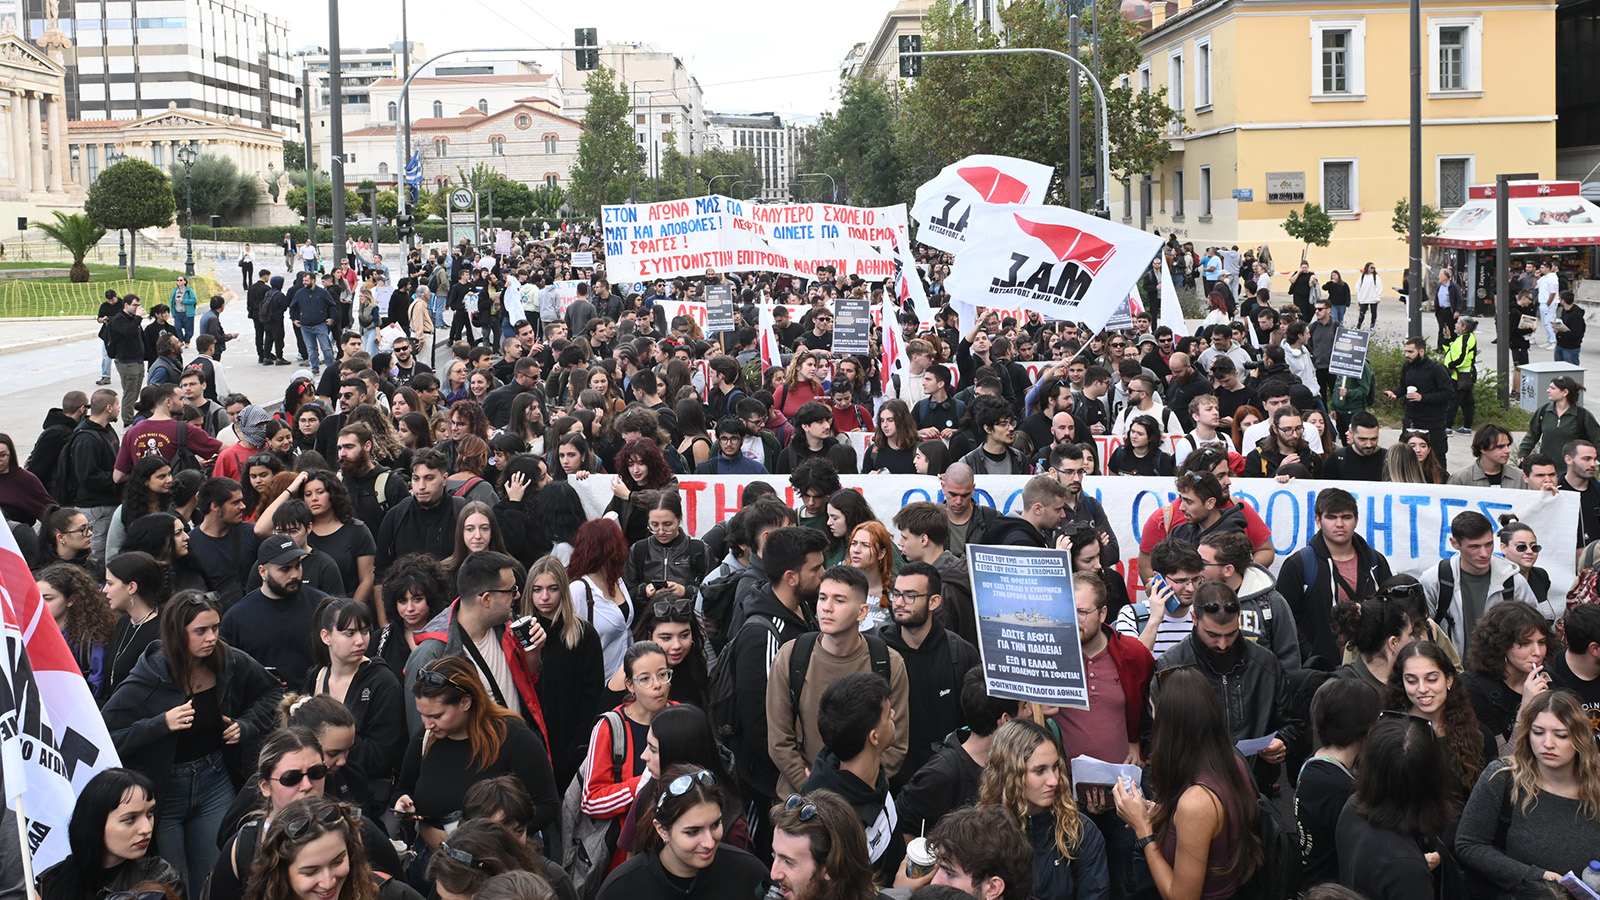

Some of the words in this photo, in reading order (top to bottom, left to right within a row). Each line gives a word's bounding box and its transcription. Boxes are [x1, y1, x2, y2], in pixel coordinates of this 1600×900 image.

[604, 207, 638, 223] ΣΤΟΝ
[649, 201, 690, 221] ΑΓΩΝΑ
[696, 196, 721, 215] ΜΑΣ
[726, 199, 743, 216] ΓΙΑ
[752, 206, 813, 223] ΚΑΛΥΤΕΡΟ
[823, 205, 875, 226] ΣΧΟΛΕΙΟ
[605, 227, 628, 240] ΜΑΤ
[634, 225, 654, 239] ΚΑΙ
[733, 217, 765, 236] ΛΕΦΤΑ
[773, 225, 815, 239] ΔΙΝΕΤΕ
[821, 225, 839, 238] ΓΙΑ
[607, 242, 623, 256] ΚΑΙ
[630, 236, 677, 255] ΣΦΑΓΕΣ
[737, 250, 789, 269] ΕΠΙΤΡΟΠΗ
[982, 554, 994, 562] ΕΤΟΣ
[1011, 577, 1038, 585] ΦΡΕΓΑΤΑΣ
[993, 590, 1006, 598] ΣΤΗΝ
[1006, 592, 1027, 600] ΕΡΥΘΡΑ
[1030, 586, 1062, 594] ΚΥΒΕΡΝΗΣΗ
[1001, 628, 1025, 640] ΔΩΣΤΕ
[1027, 632, 1055, 643] ΛΕΦΤΑ
[997, 639, 1009, 650] ΓΙΑ
[1011, 641, 1026, 652] ΤΗΝ
[1028, 643, 1062, 655] ΠΑΙΔΕΙΑ!
[1006, 655, 1020, 665] ΕΞΩ
[1021, 657, 1027, 666] Η
[1028, 658, 1058, 669] ΕΛΛΑΔΑ
[999, 665, 1010, 673] ΤΟΥ
[1011, 667, 1039, 676] ΠΟΛΕΜΟΥ
[1041, 670, 1050, 678] ΤΑ
[1051, 671, 1080, 680] ΣΦΑΓΕΙΑ!
[990, 680, 1024, 692] ΦΟΙΤΗΤΙΚΟΙ
[1025, 685, 1056, 696] ΣΥΛΛΟΓΟΙ
[1057, 689, 1083, 698] ΑΘΗΝΑΣ
